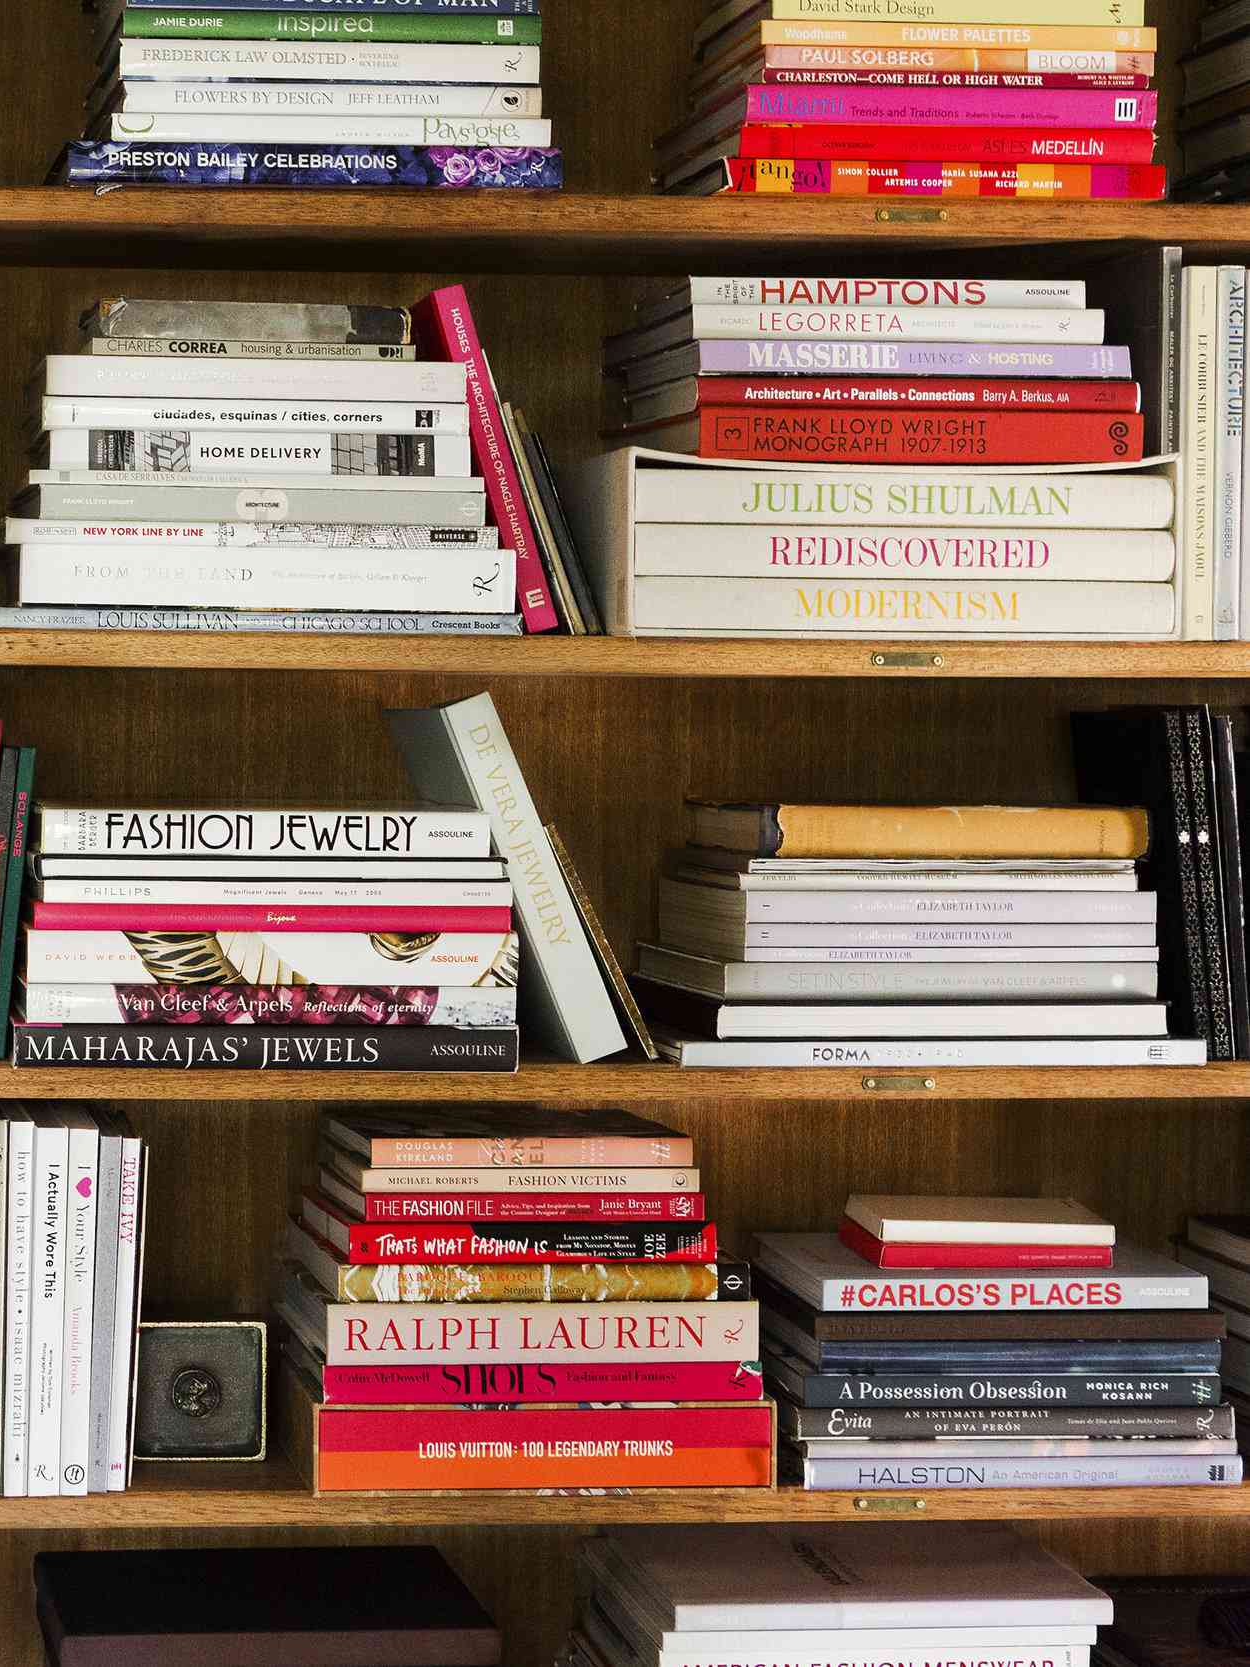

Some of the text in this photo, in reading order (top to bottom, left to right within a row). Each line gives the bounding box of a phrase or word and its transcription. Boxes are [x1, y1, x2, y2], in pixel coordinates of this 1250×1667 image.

[887, 1, 935, 18] Design
[152, 17, 224, 28] JAMIE DURIE
[902, 27, 1031, 43] FLOWER PALETTES
[142, 49, 231, 64] FREDERICK
[236, 50, 266, 64] LAW
[272, 51, 348, 66] OLMSTED
[802, 48, 935, 67] PAUL SOLBERG
[1038, 55, 1107, 71] BLOOM
[174, 89, 334, 106] FLOWERS BY DESIGN
[346, 92, 440, 107] JEFF LEATHAM
[108, 151, 398, 170] PRESTON BAILEY CELEBRATIONS
[885, 178, 953, 188] ARTEMIS COOPER
[759, 279, 987, 306] HAMPTONS
[1024, 288, 1072, 297] ASSOULINE
[450, 307, 471, 354] HOUSES
[758, 311, 904, 333] LEGORRETA
[106, 340, 163, 353] CHARLES
[168, 341, 228, 355] CORREA
[240, 343, 282, 357] housing
[298, 345, 363, 357] urbanisation
[747, 342, 901, 370] MASSERIE
[464, 357, 479, 380] THE
[744, 386, 976, 403] Architecture Art Parallels Connections
[981, 390, 1070, 407] Barry A. Berkus, AIA
[153, 410, 216, 422] ciudades,
[219, 411, 278, 424] esquinas
[333, 413, 383, 423] corners
[470, 380, 501, 460] ARCHITECTURE
[753, 416, 987, 437] FRANK LLOYD WRIGHT
[199, 446, 322, 459] HOME DELIVERY
[753, 436, 889, 453] MONOGRAPH
[498, 476, 516, 513] NAGLE
[741, 482, 1073, 516] JULIUS SHULMAN
[83, 527, 205, 538] NEW YORK LINE BY LINE
[509, 512, 530, 561] HARTRAY
[767, 536, 1051, 569] REDISCOVERED
[793, 587, 1022, 621] MODERNISM
[97, 611, 149, 629] LOUIS
[153, 611, 239, 630] SULLIVAN
[431, 618, 500, 631] Crescent Books
[13, 791, 29, 858] SOLANGE
[105, 813, 254, 851] FASHION
[269, 815, 418, 853] JEWELRY
[427, 830, 475, 839] ASSOULINE
[469, 722, 573, 947] DE VERA JEWELRY
[83, 887, 152, 897] PHILLIPS
[430, 955, 479, 964] ASSOULINE
[120, 991, 294, 1019] Van Cleef & Arpels
[302, 1000, 434, 1017] Reflections of eternity
[25, 1034, 382, 1070] MAHARAJAS’ JEWELS
[429, 1044, 507, 1057] ASSOULINE
[812, 1047, 871, 1062] FORMA
[395, 1142, 454, 1151] DOUGLAS
[395, 1153, 454, 1163] KIRKLAND
[388, 1175, 479, 1185] MICHAEL ROBERTS
[507, 1174, 628, 1187] FASHION VICTIMS
[44, 1173, 60, 1228] Actually
[120, 1157, 136, 1244] TAKE IVY
[373, 1199, 494, 1217] THE FASHION FILE
[599, 1199, 625, 1211] Janie
[628, 1199, 662, 1214] Bryant
[45, 1232, 58, 1267] Wore
[423, 1237, 467, 1255] WHAT
[470, 1236, 529, 1257] FASHION
[534, 1239, 549, 1256] IS
[643, 1232, 656, 1260] JOE
[656, 1232, 668, 1260] ZEE
[44, 1271, 56, 1299] This
[840, 1282, 1123, 1308] #CARLOS’S PLACES
[343, 1315, 708, 1352] RALPH LAUREN
[838, 1380, 1068, 1401] A Possession Obsession
[1086, 1382, 1169, 1391] MONICA RICH
[1102, 1392, 1153, 1401] KOSANN
[826, 1407, 873, 1436] Evita
[904, 1410, 1050, 1419] AN INTIMATE PORTRAIT
[934, 1421, 1022, 1433] OF EVA PERÓN
[418, 1440, 675, 1460] LOUIS VUITTON: 100 LEGENDARY TRUNKS
[858, 1466, 986, 1485] HALSTON
